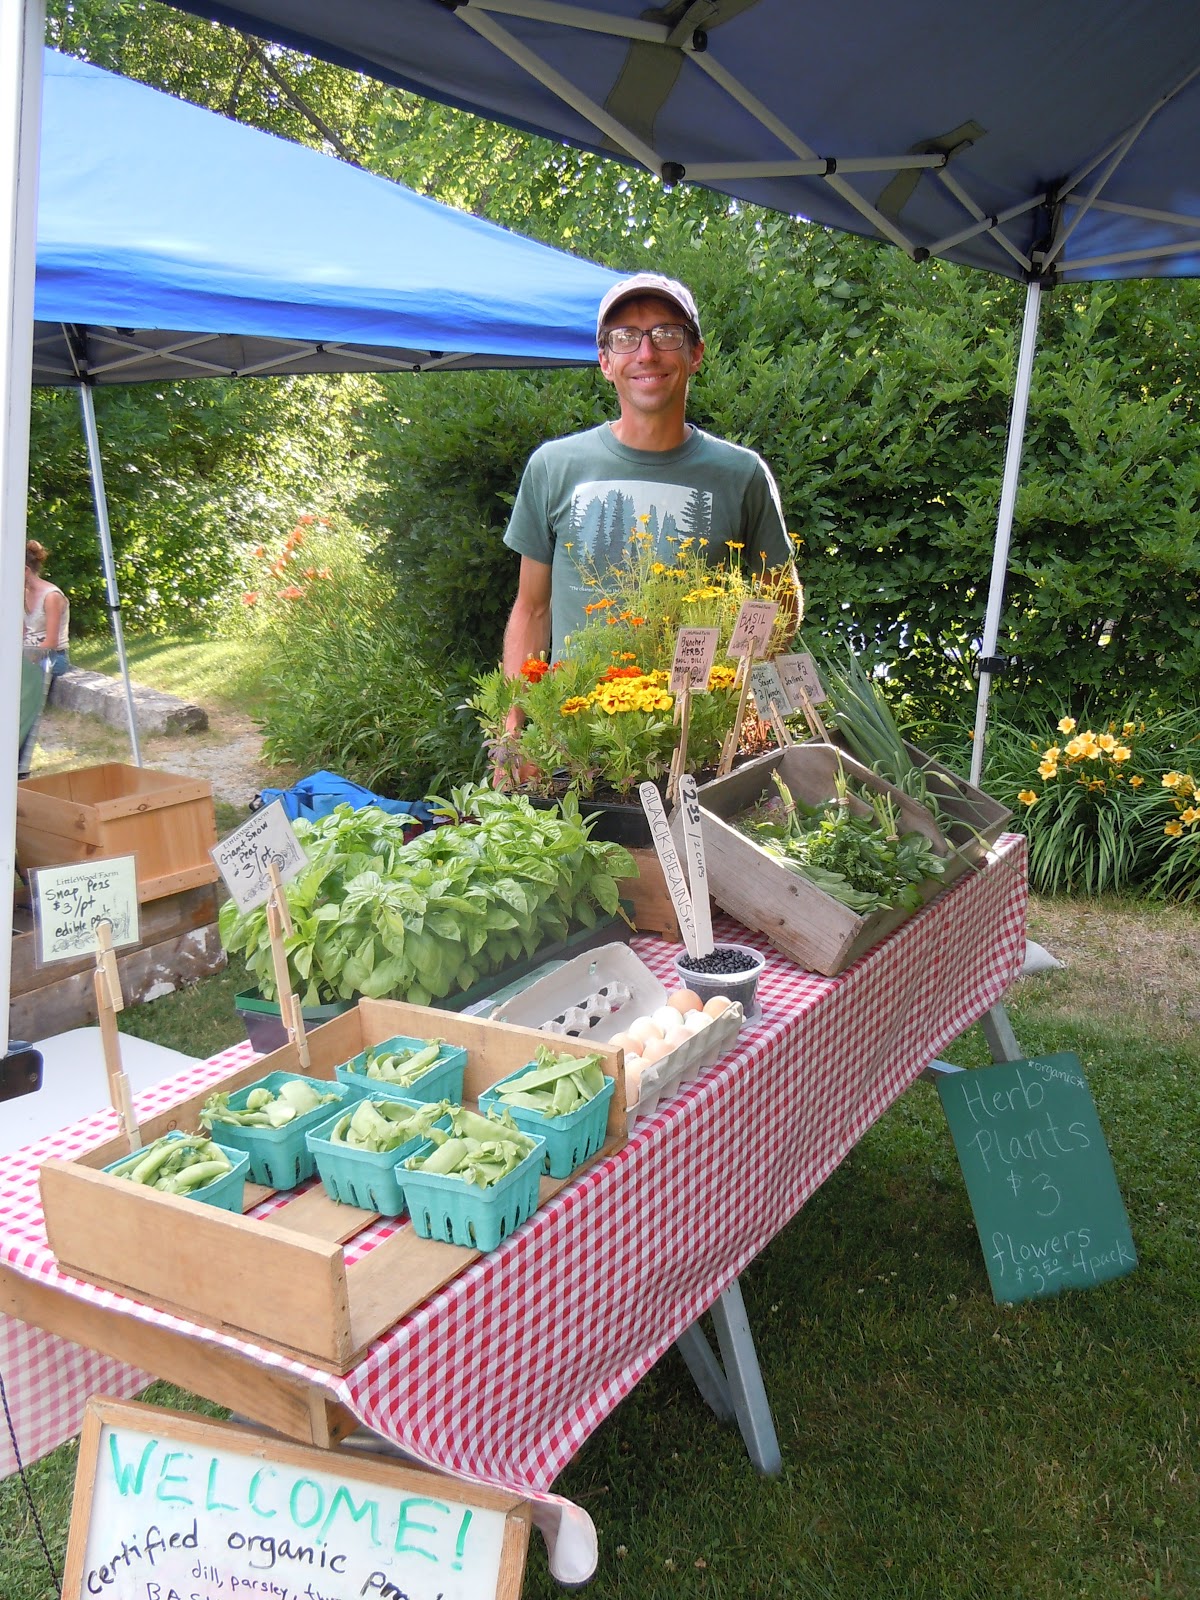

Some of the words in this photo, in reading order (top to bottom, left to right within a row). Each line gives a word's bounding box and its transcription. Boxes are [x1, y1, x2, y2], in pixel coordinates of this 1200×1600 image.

[739, 612, 766, 628] BASIL
[682, 647, 704, 658] HERBS
[220, 840, 247, 864] Giant
[246, 821, 268, 842] Snow
[642, 785, 671, 848] BLACK
[662, 848, 692, 918] BEANS
[45, 888, 79, 901] Snap
[56, 872, 97, 886] LittleWood
[56, 920, 86, 938] edible
[961, 1068, 1044, 1122] Herb
[992, 1228, 1090, 1277] flowers
[109, 1432, 473, 1571] WELCOME!
[87, 1518, 199, 1595] certified
[227, 1532, 348, 1574] organic
